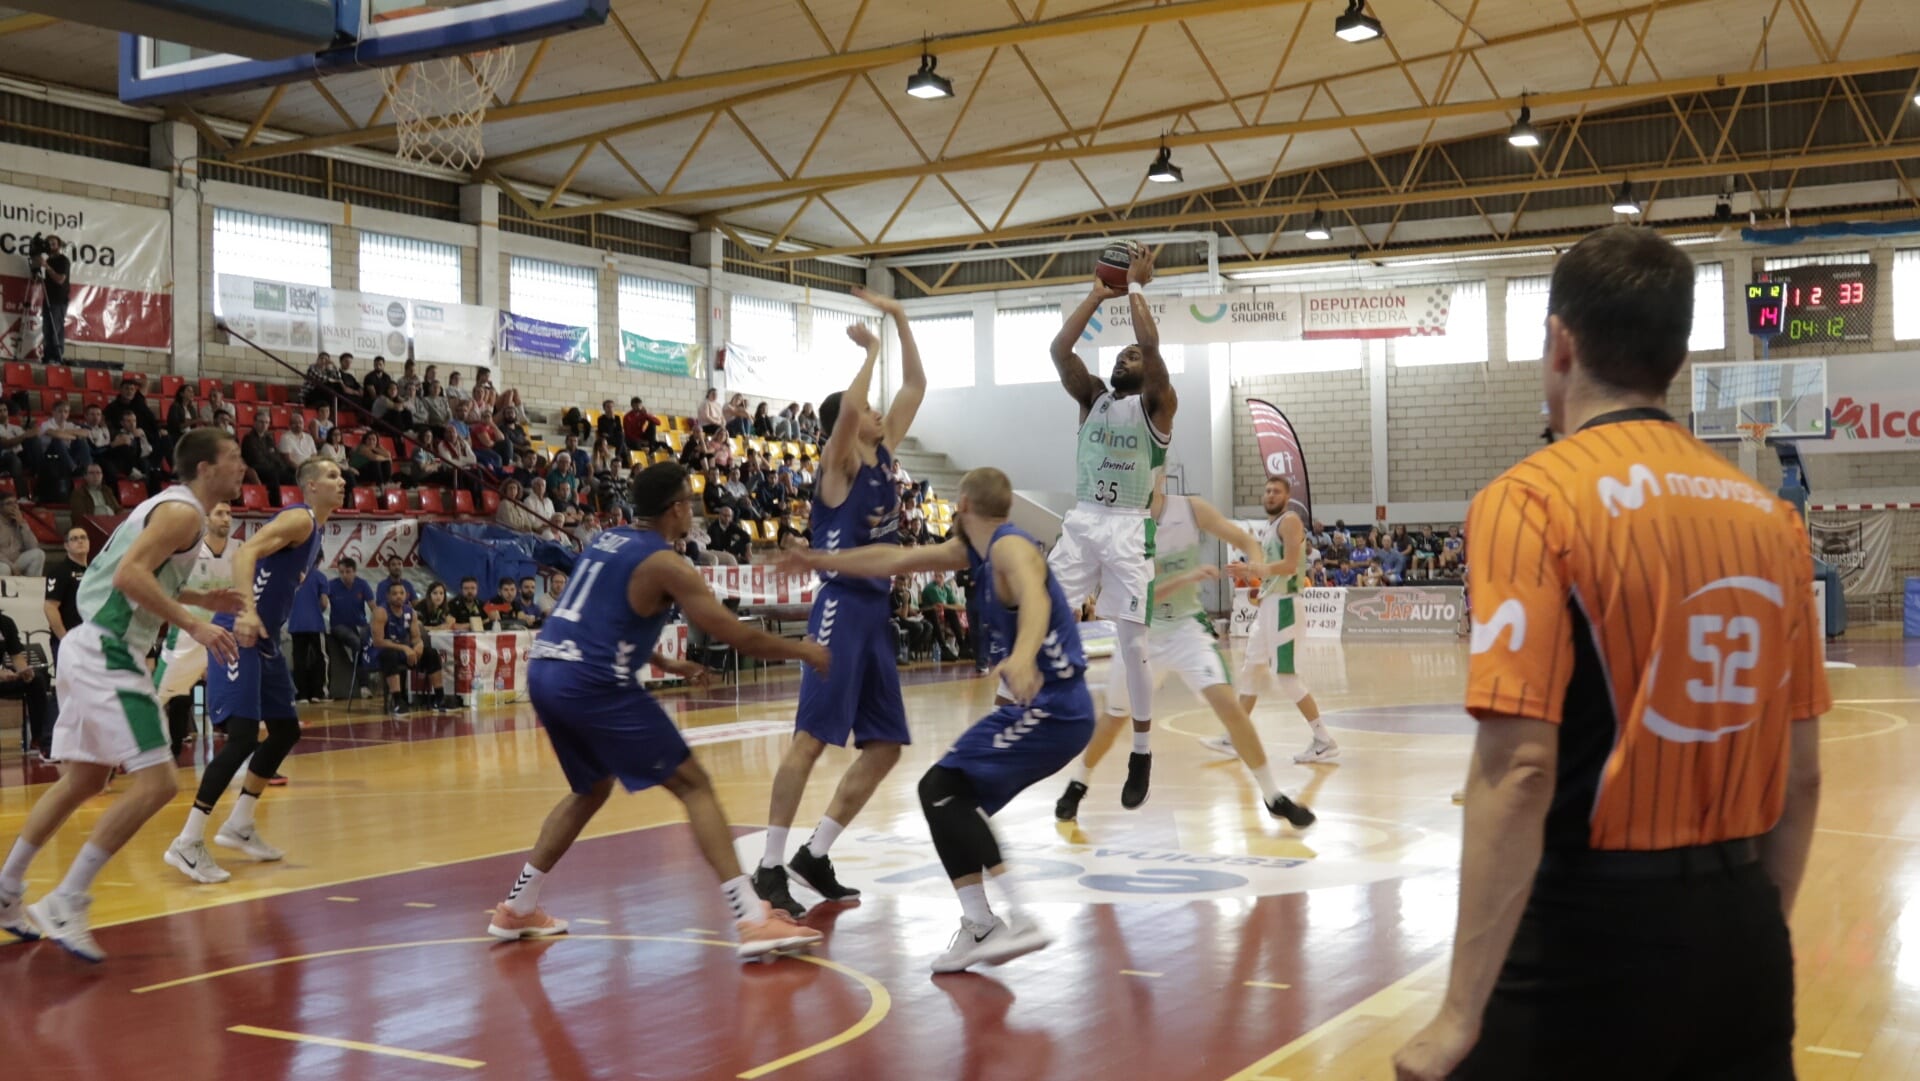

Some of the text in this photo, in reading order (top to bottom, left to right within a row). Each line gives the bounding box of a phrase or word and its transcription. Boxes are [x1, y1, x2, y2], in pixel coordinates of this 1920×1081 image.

[0, 203, 83, 230] unicipal
[1310, 292, 1406, 311] DEPUTACIÓN
[1749, 287, 1761, 298] 04
[1810, 287, 1822, 305] 2
[1839, 282, 1863, 304] 33
[1110, 303, 1167, 315] DETE
[1231, 301, 1274, 312] GALICIA
[1110, 316, 1160, 327] GALO
[1231, 311, 1287, 323] SAUDABLE
[1310, 309, 1408, 325] PONTEVEDRA
[1760, 307, 1778, 326] 14
[1095, 480, 1118, 503] 35
[552, 558, 605, 622] 11
[1685, 614, 1760, 704] 52
